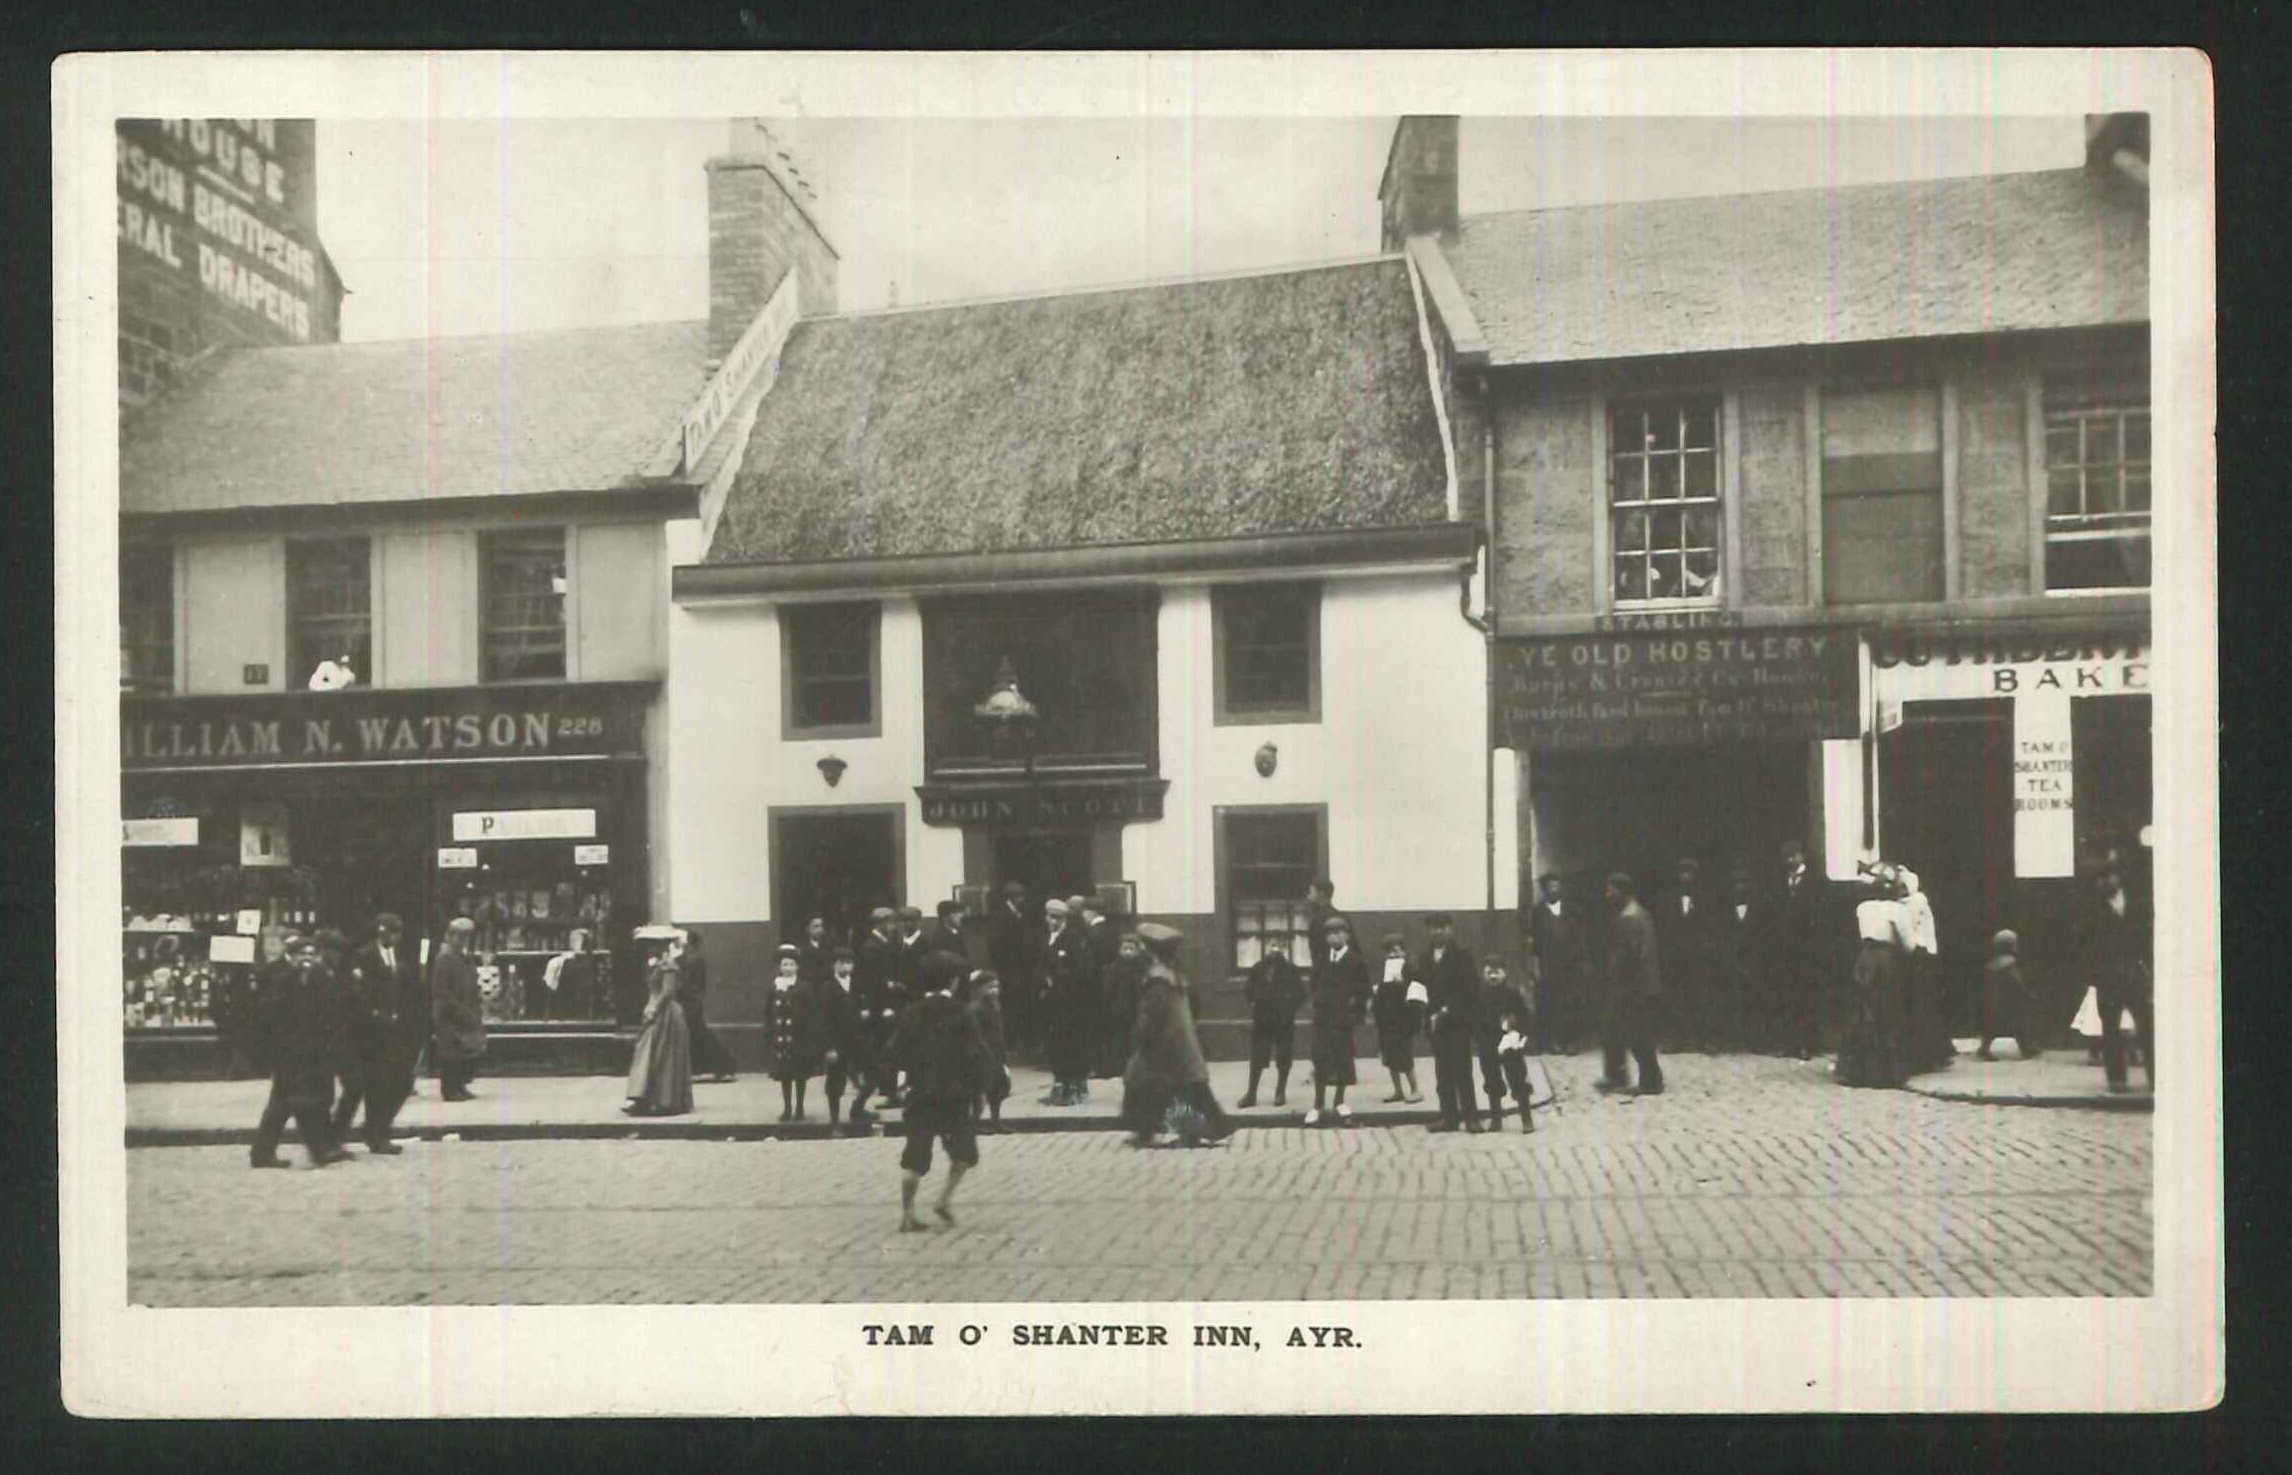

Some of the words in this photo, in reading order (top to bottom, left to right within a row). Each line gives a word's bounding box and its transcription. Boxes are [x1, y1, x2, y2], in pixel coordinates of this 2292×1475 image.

[194, 183, 315, 288] BROTHERS
[199, 242, 309, 342] DRAPERS
[1519, 645, 1557, 668] YE
[1571, 642, 1632, 665] OLD
[1648, 635, 1828, 664] HOSTLERY
[303, 719, 344, 754] N.
[357, 712, 550, 754] WATSON
[2021, 741, 2054, 754] TAM
[2027, 778, 2062, 792] TEA
[928, 799, 1012, 820] JOHN
[2013, 797, 2074, 812] ROOMS
